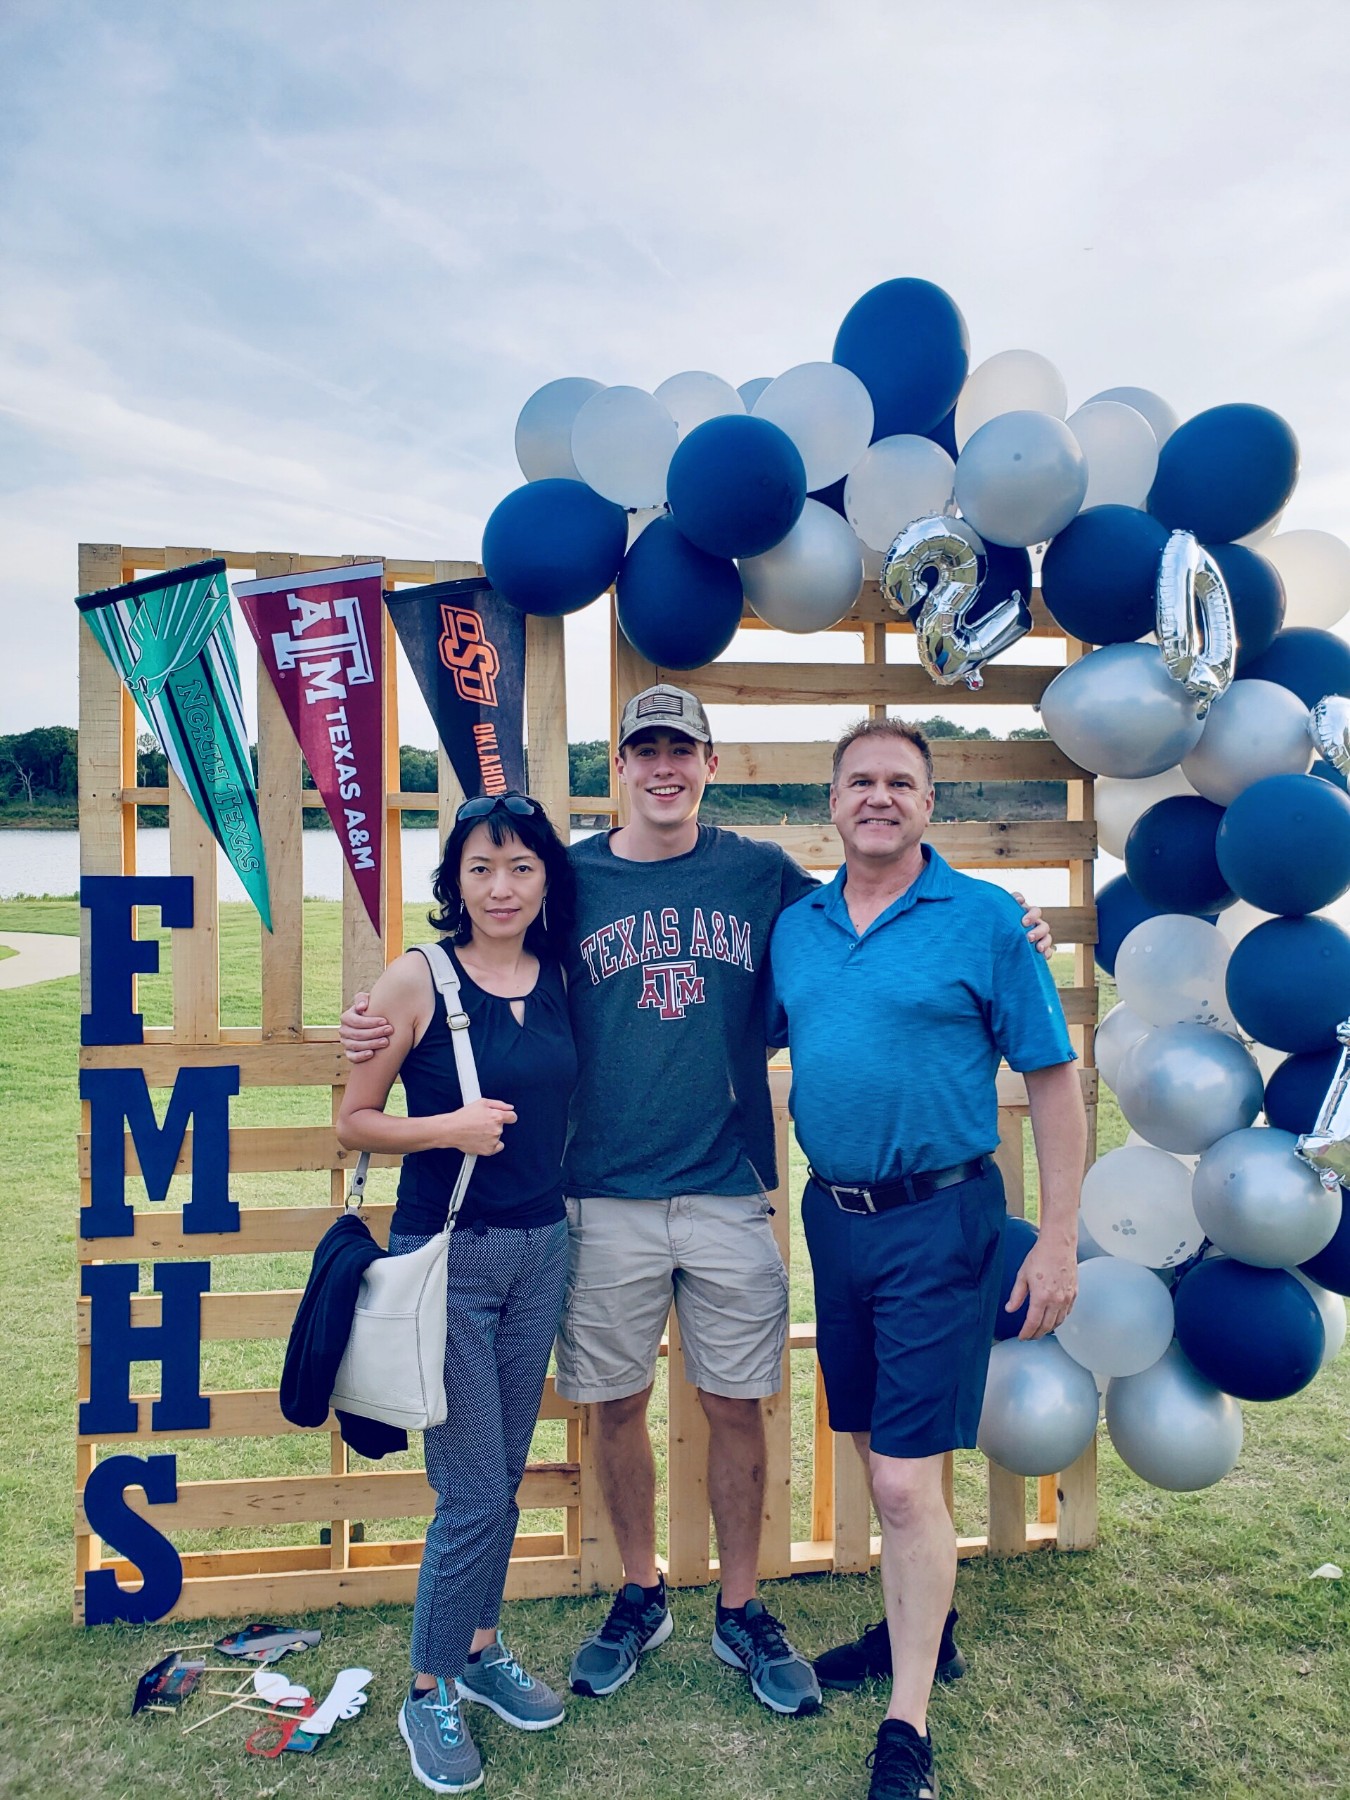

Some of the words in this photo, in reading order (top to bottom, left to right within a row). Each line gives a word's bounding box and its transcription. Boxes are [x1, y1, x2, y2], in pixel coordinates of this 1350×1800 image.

[438, 604, 500, 707] OSU
[176, 680, 229, 782] NORTH
[214, 784, 260, 872] TEXAS
[326, 706, 361, 800] TEXAS
[344, 808, 376, 870] A&M
[472, 722, 508, 797] OKLAHOM
[580, 908, 681, 985] TEXAS
[690, 908, 755, 972] A&M
